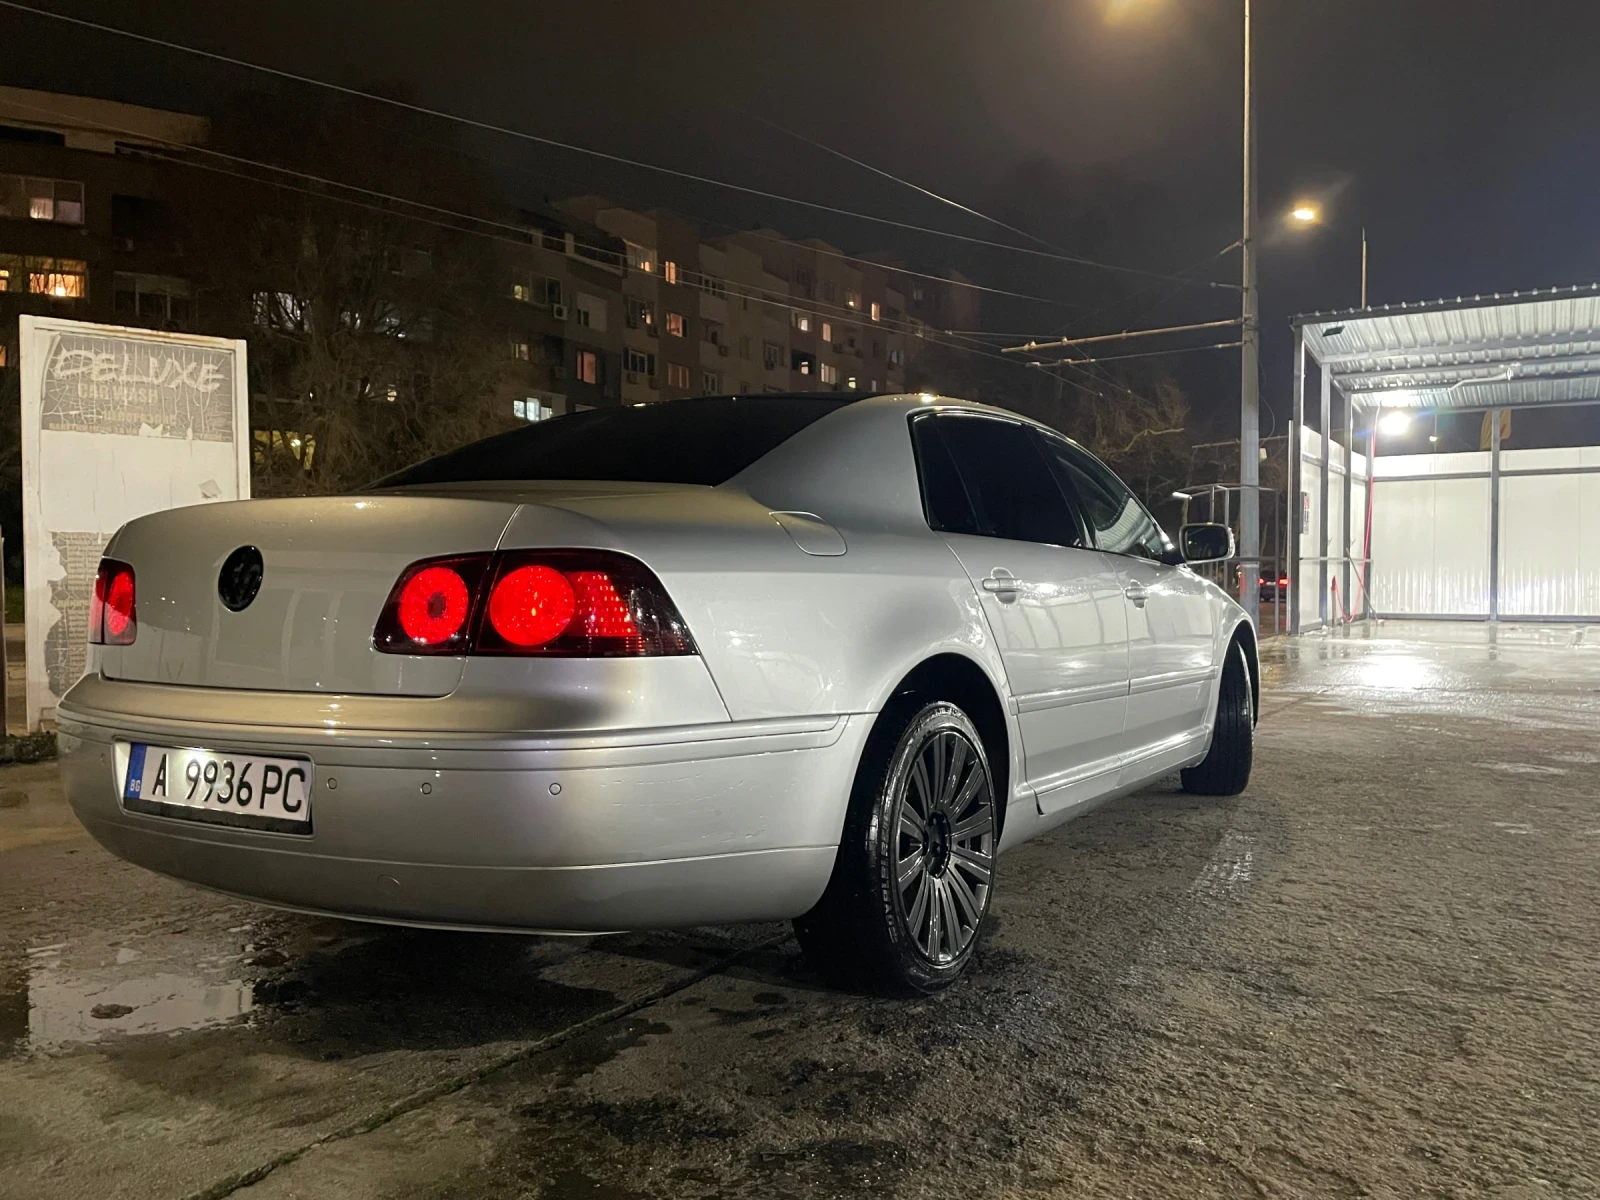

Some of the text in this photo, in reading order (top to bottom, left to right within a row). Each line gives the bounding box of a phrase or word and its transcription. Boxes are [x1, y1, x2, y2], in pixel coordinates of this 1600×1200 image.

[53, 349, 225, 393] DELUXE
[78, 382, 158, 402] CAR WASH
[129, 779, 141, 791] BG
[152, 753, 306, 813] A 9936 PC
